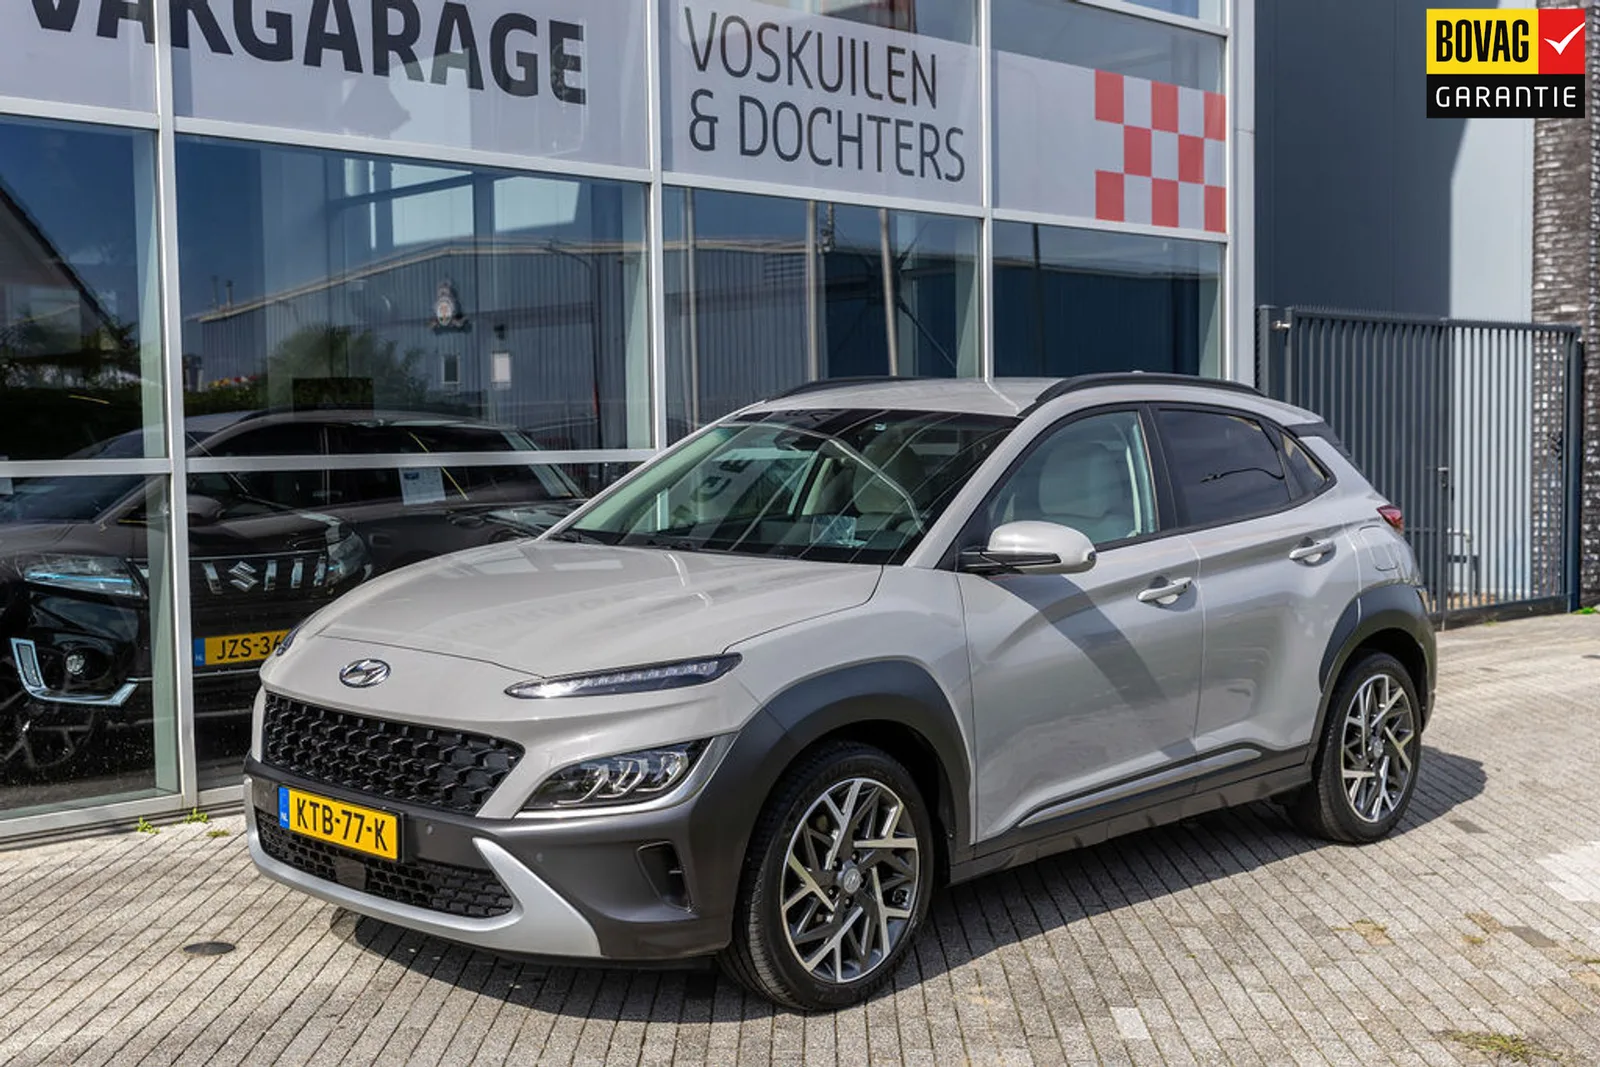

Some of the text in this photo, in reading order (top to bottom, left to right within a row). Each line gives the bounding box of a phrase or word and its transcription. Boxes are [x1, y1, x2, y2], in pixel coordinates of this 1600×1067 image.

[685, 7, 937, 109] VOSKUILEN
[689, 89, 965, 182] & DOCHTERS
[297, 797, 388, 852] KTB-77-K
